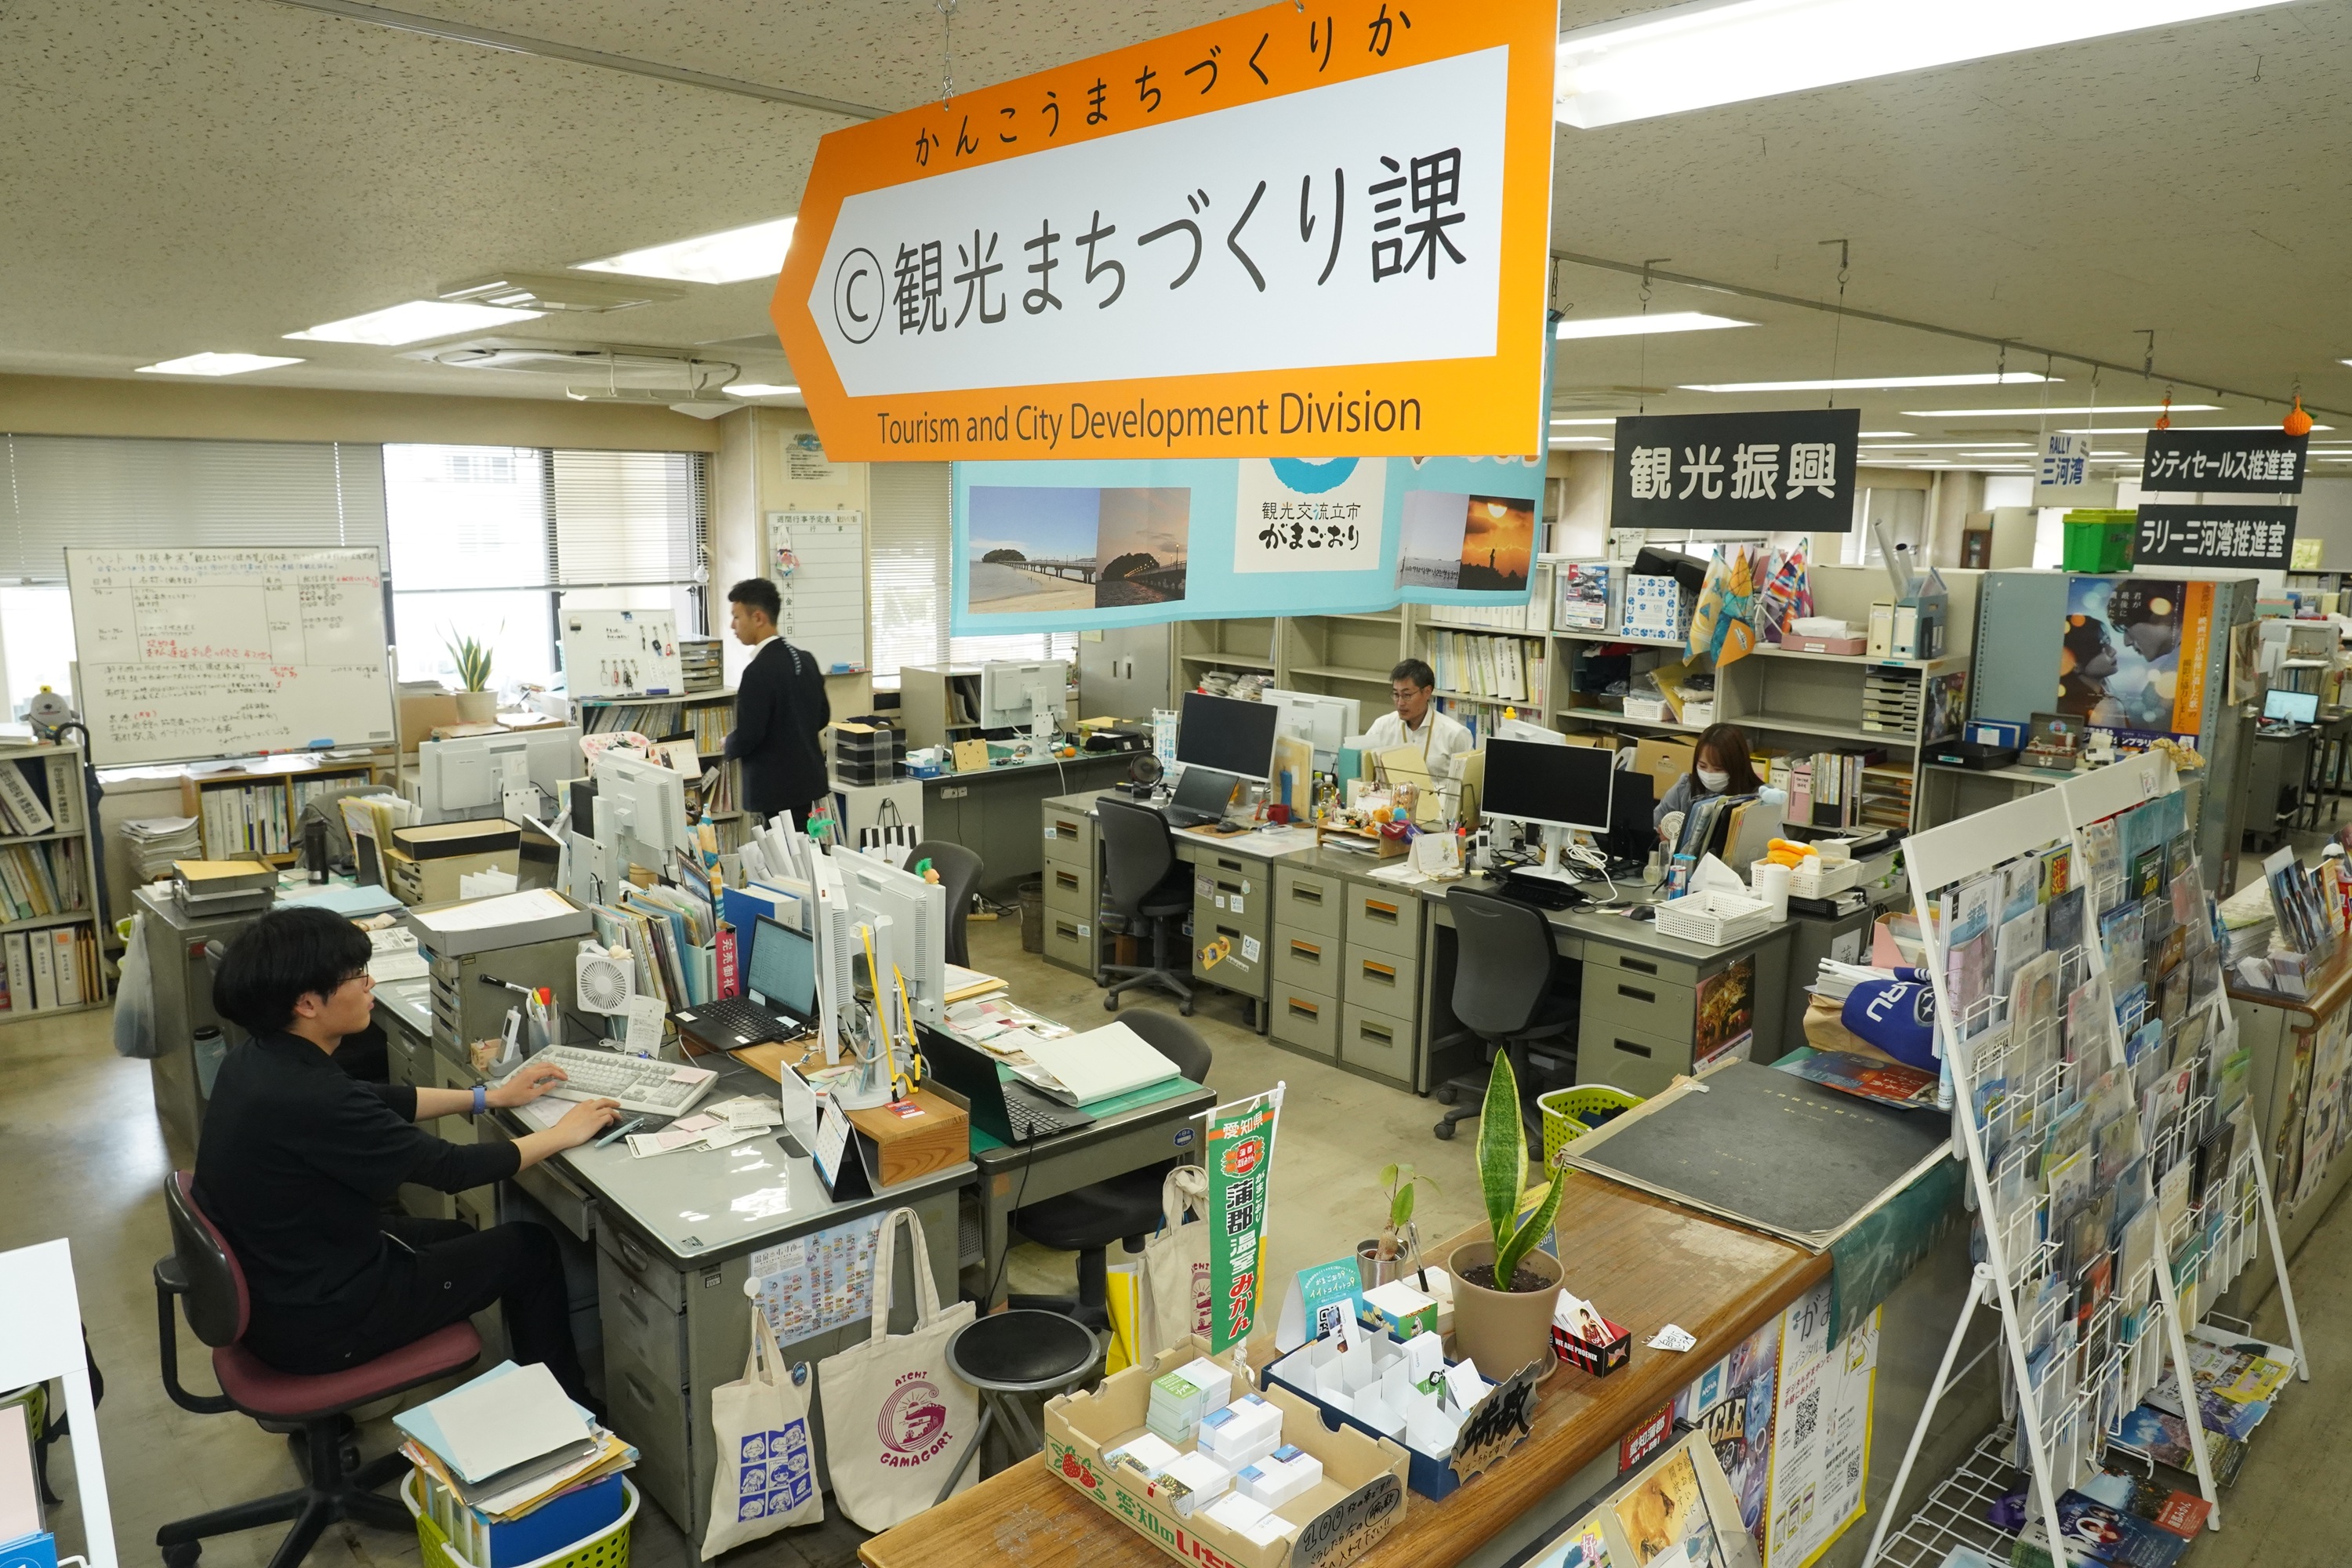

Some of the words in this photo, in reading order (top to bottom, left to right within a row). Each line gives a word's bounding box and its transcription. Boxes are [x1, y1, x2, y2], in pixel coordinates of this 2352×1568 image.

[914, 3, 1414, 169] かんこうまちづくりか
[877, 412, 960, 445] Tourism
[967, 407, 1009, 442] and
[1014, 405, 1063, 450] City
[1071, 396, 1269, 448] Development
[1279, 390, 1422, 435] Division
[2048, 436, 2072, 455] RALLY
[1628, 441, 1838, 500] 観光振興
[2040, 457, 2085, 486] 三河湾
[2150, 448, 2297, 481] シティセールス推進室
[1261, 500, 1363, 521] 観光交流立市
[1258, 522, 1362, 550] がまごおり
[2141, 519, 2286, 558] ラリー三河湾推進室
[722, 938, 735, 989] 完売御礼
[1223, 1110, 1263, 1139] 愛知県
[1255, 1169, 1265, 1223] がまごおり
[1555, 1338, 1564, 1347] WE
[1564, 1341, 1574, 1352] ARE
[1574, 1345, 1598, 1362] PHOENIX
[894, 1371, 928, 1388] AICHI
[1701, 1381, 1717, 1396] NOVA
[1697, 1401, 1718, 1418] PRESENTS
[880, 1431, 954, 1468] GAMAGORI
